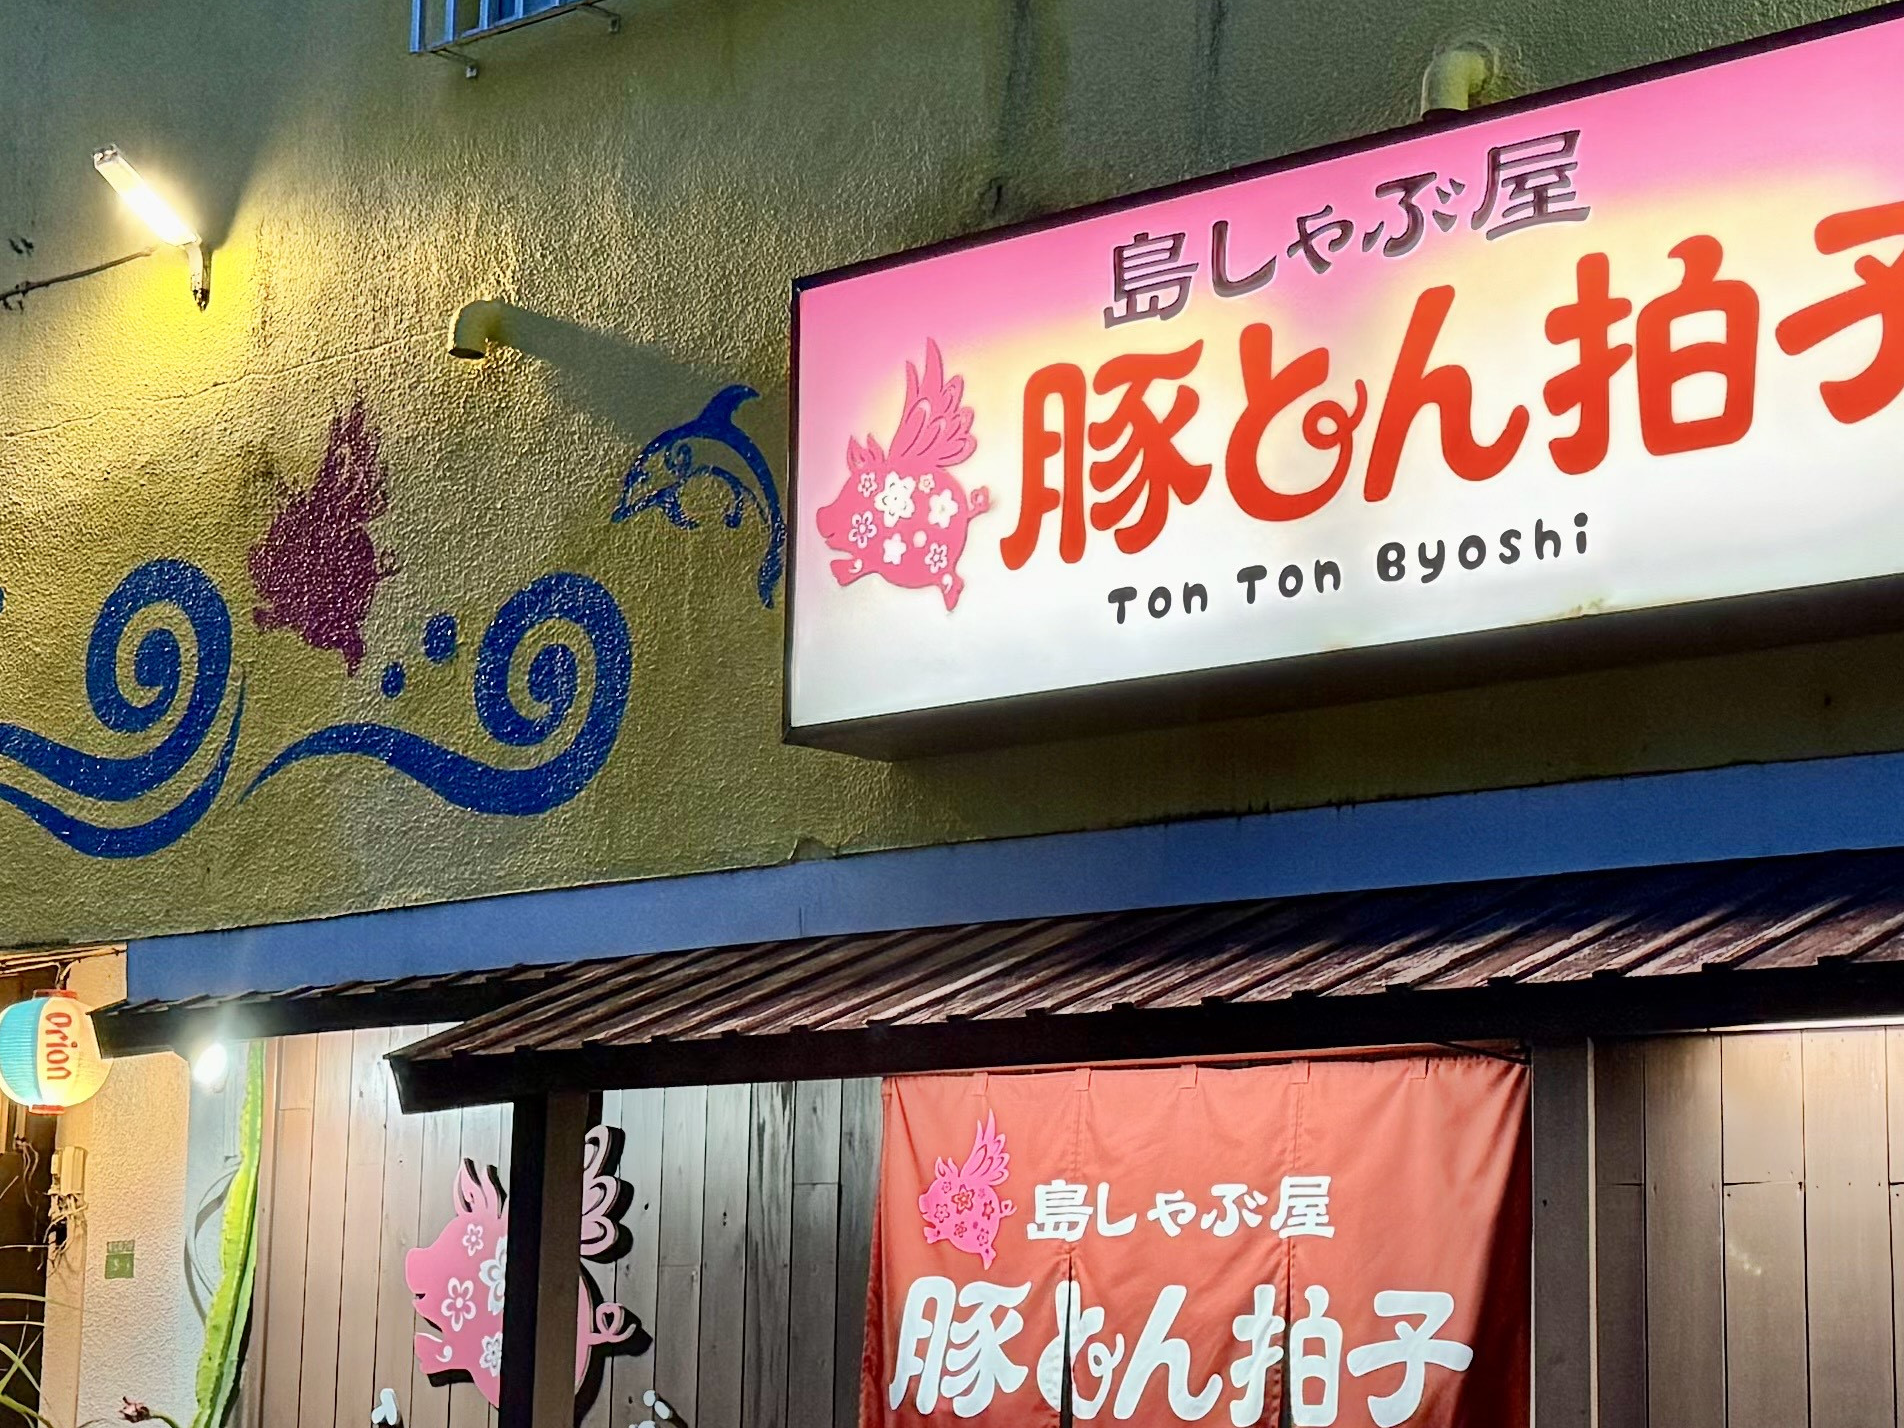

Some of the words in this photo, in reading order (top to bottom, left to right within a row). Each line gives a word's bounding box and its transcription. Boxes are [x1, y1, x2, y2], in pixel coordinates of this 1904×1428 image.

[1103, 129, 1591, 329] 島しゃぶ屋
[1108, 581, 1209, 624] Ton
[1237, 559, 1341, 604] Ton
[1377, 512, 1589, 583] Byoshi
[1026, 1175, 1335, 1243] 島しゃぶ屋
[889, 1276, 1474, 1428] 豚とん拍子
